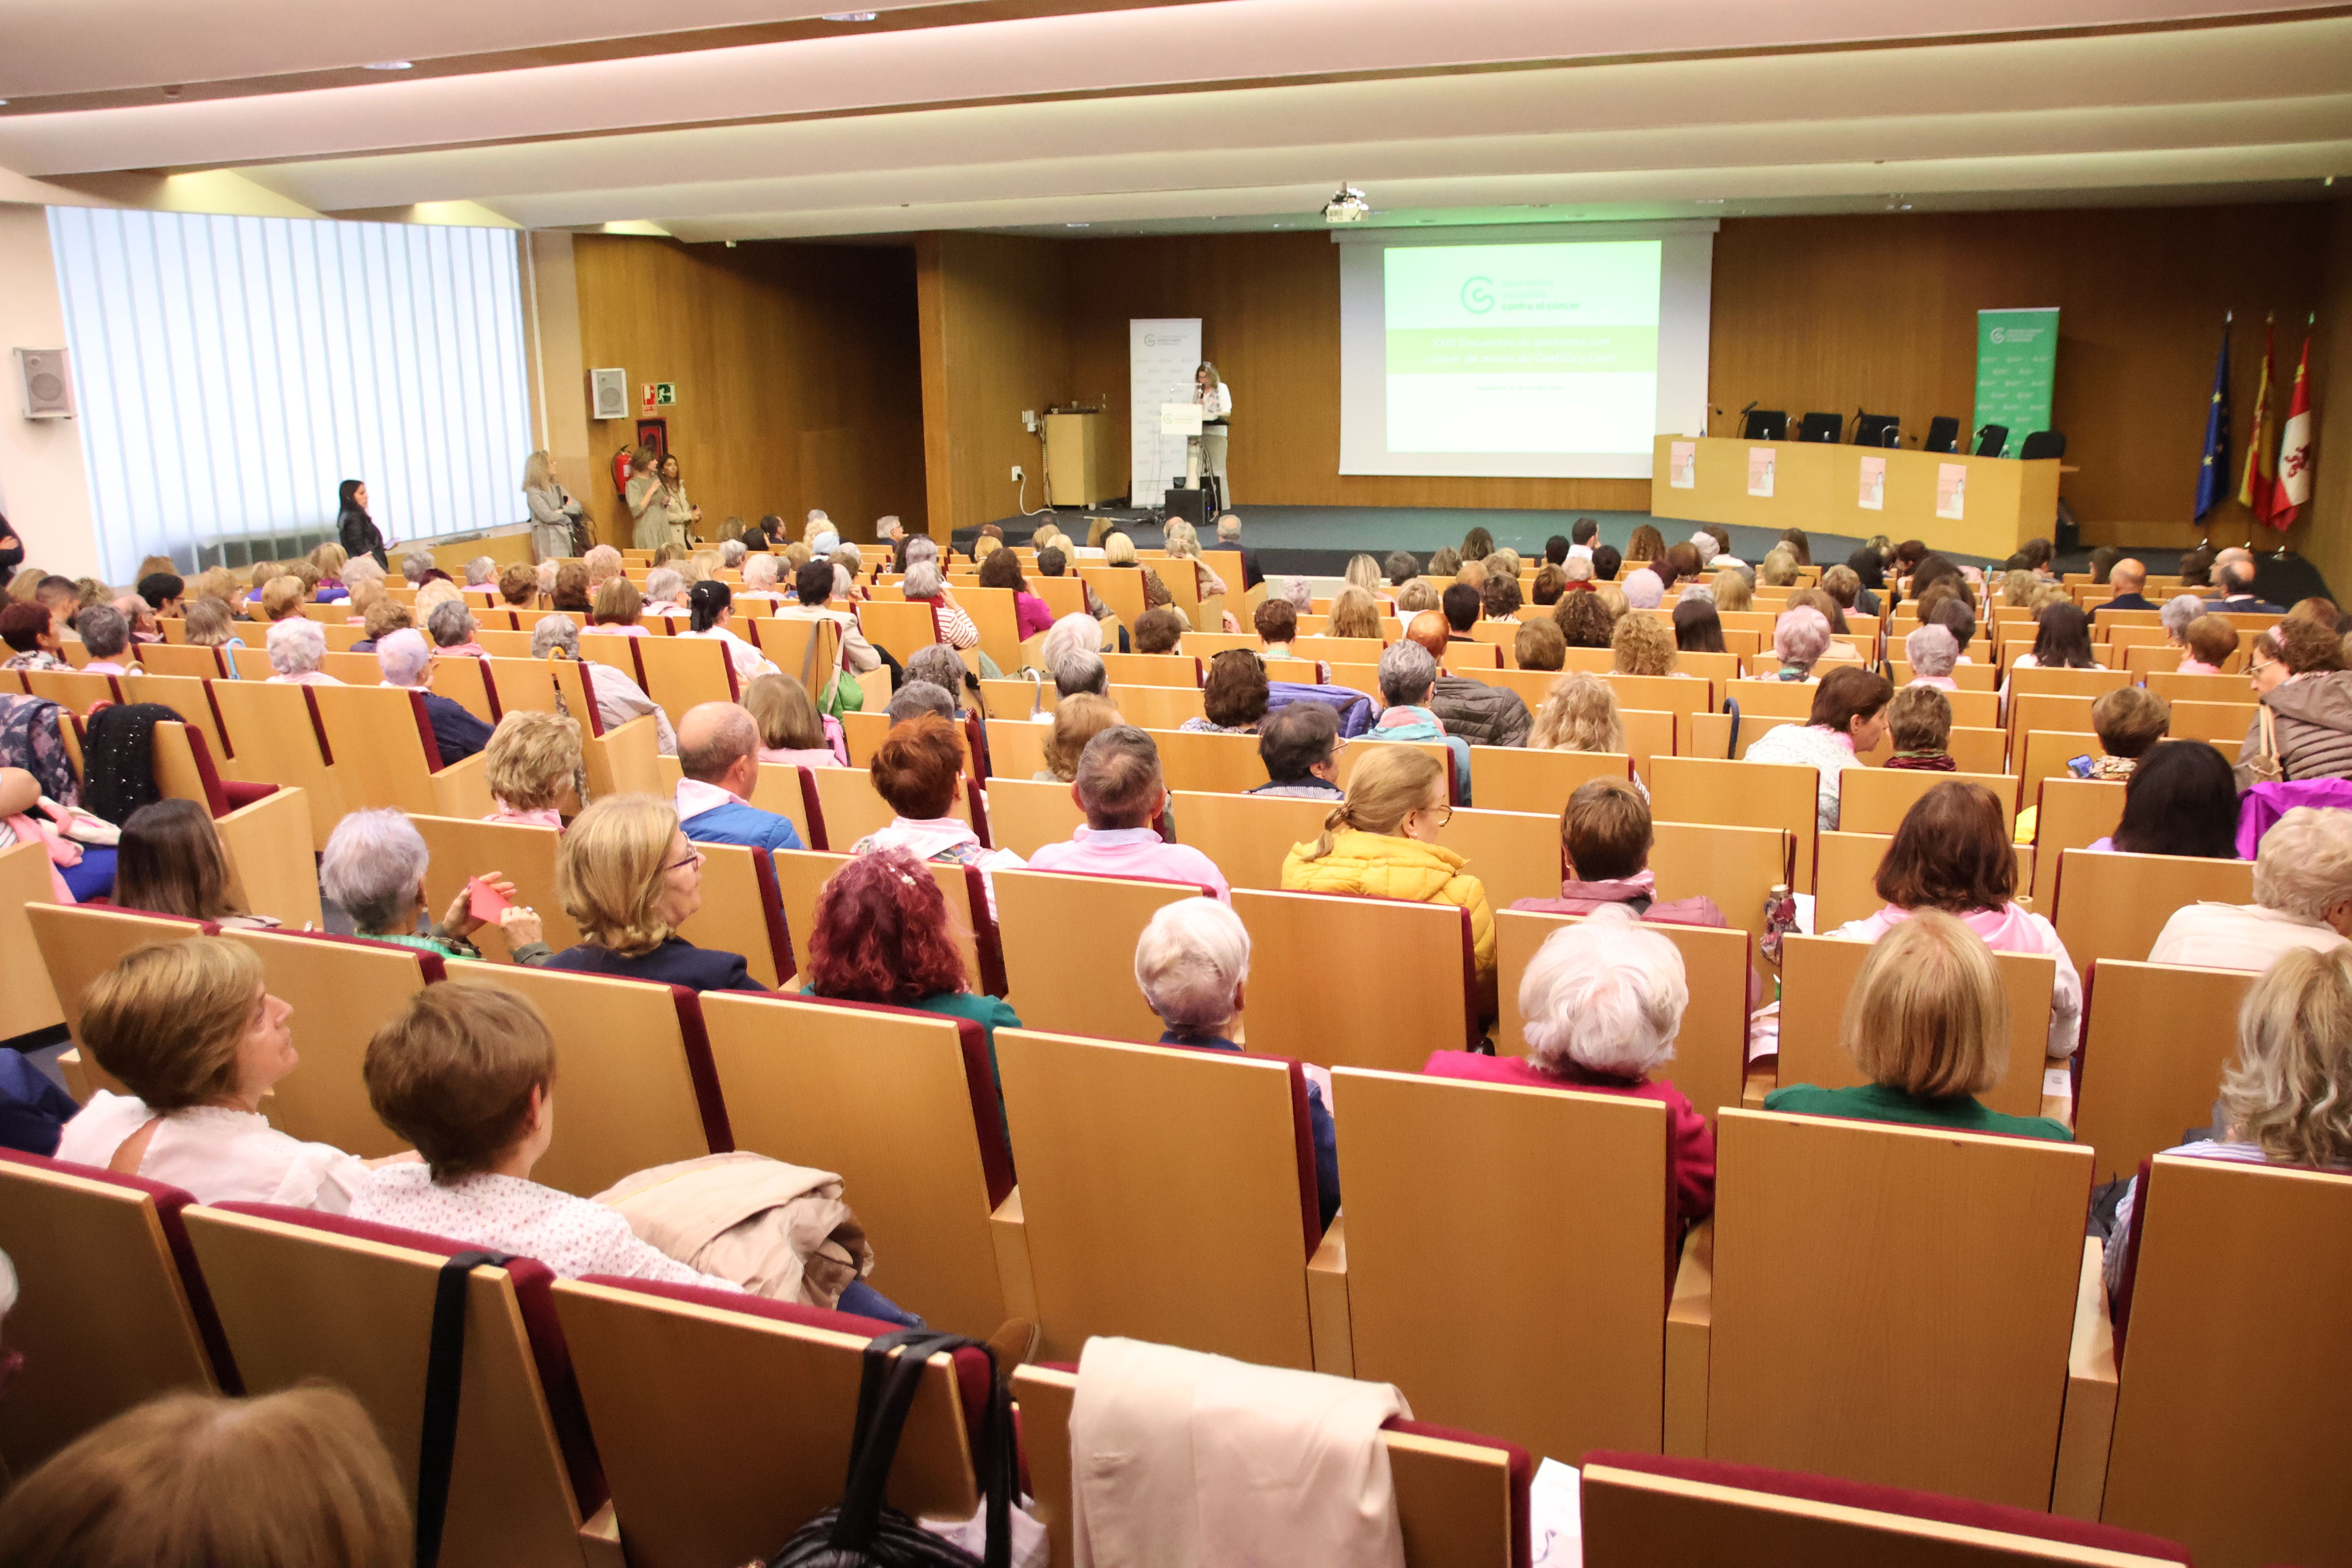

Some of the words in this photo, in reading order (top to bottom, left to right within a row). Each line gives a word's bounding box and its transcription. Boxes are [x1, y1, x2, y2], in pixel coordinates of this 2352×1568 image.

[1502, 302, 1533, 310] contra
[1536, 301, 1544, 310] el
[1432, 338, 1456, 347] XXIII
[1459, 338, 1515, 348] Encuentro
[1518, 338, 1532, 347] de
[1535, 338, 1586, 349] personas
[1424, 354, 1461, 364] cáncer
[1464, 354, 1478, 363] de
[1518, 353, 1532, 363] de
[1535, 353, 1576, 363] Castilla
[1579, 355, 1586, 366] y
